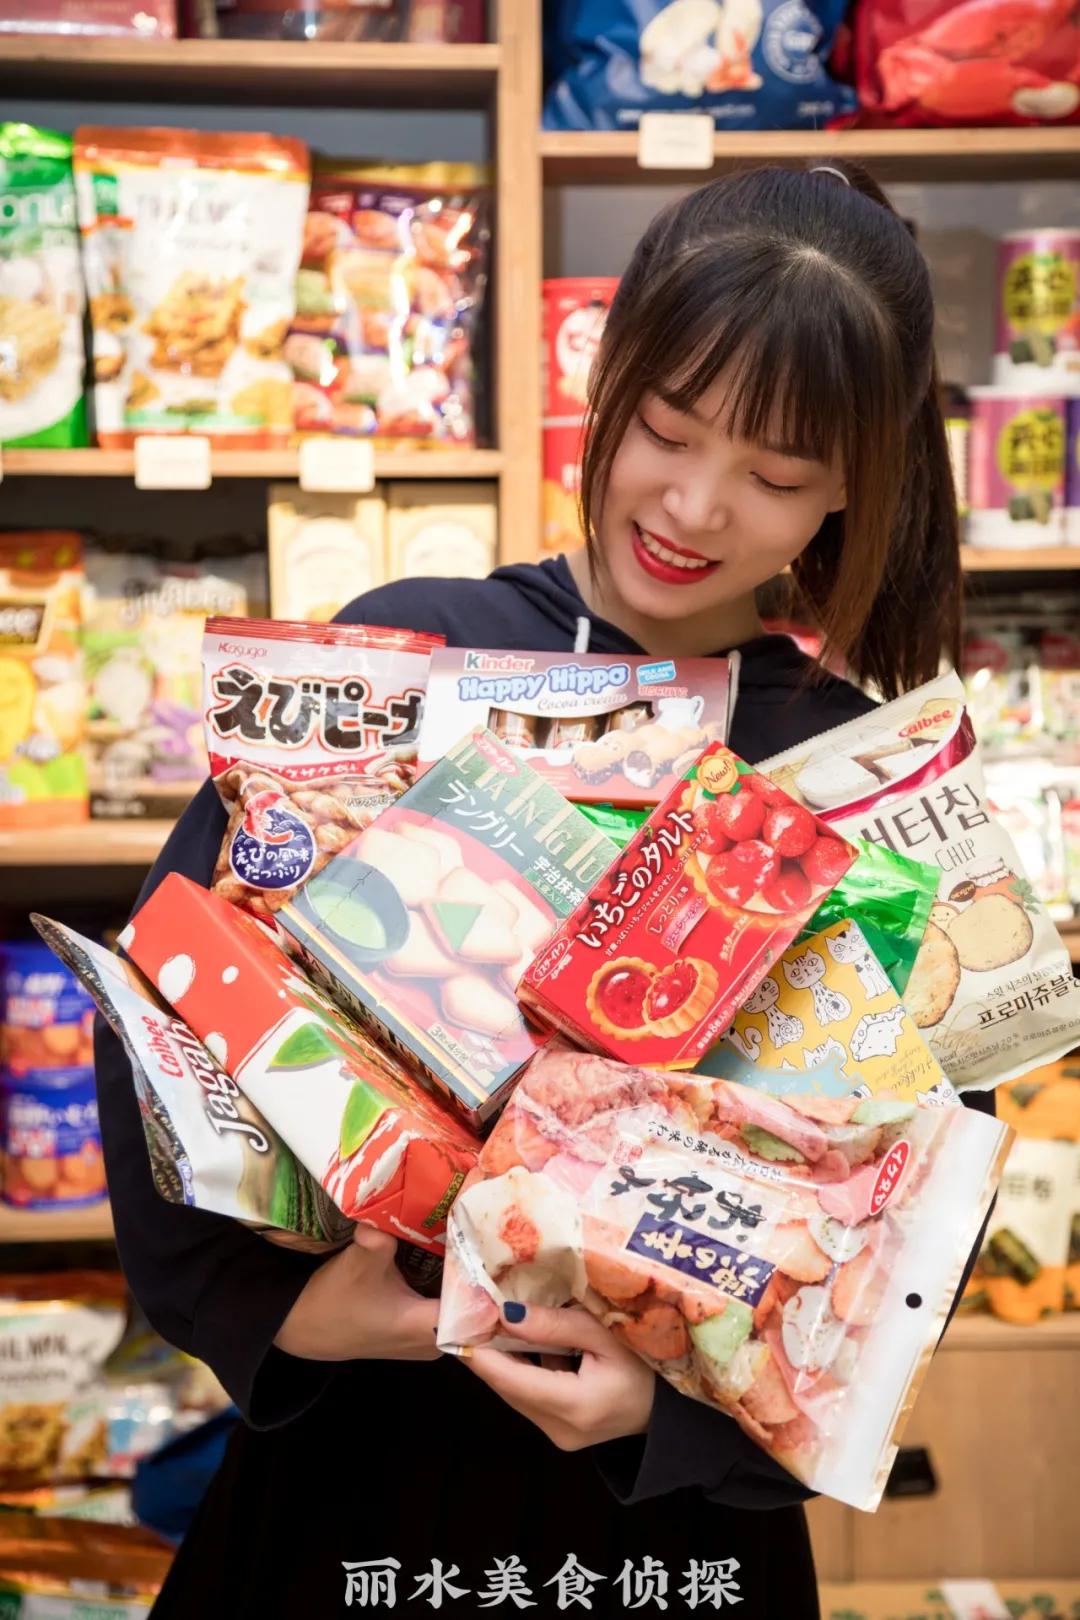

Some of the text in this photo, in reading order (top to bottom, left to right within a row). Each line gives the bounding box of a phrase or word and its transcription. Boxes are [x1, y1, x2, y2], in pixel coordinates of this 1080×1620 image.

[217, 641, 268, 660] Kasugai
[459, 663, 630, 702] Happy Hippo
[703, 759, 732, 790] New!
[439, 779, 525, 857] ラングリー
[235, 844, 311, 867] えびの風味
[243, 862, 301, 881] たっぷり
[934, 837, 976, 873] CHIP
[533, 855, 586, 906] 宇治抹茶
[575, 811, 695, 948] いちごのタルト
[140, 1014, 185, 1080] Calbee
